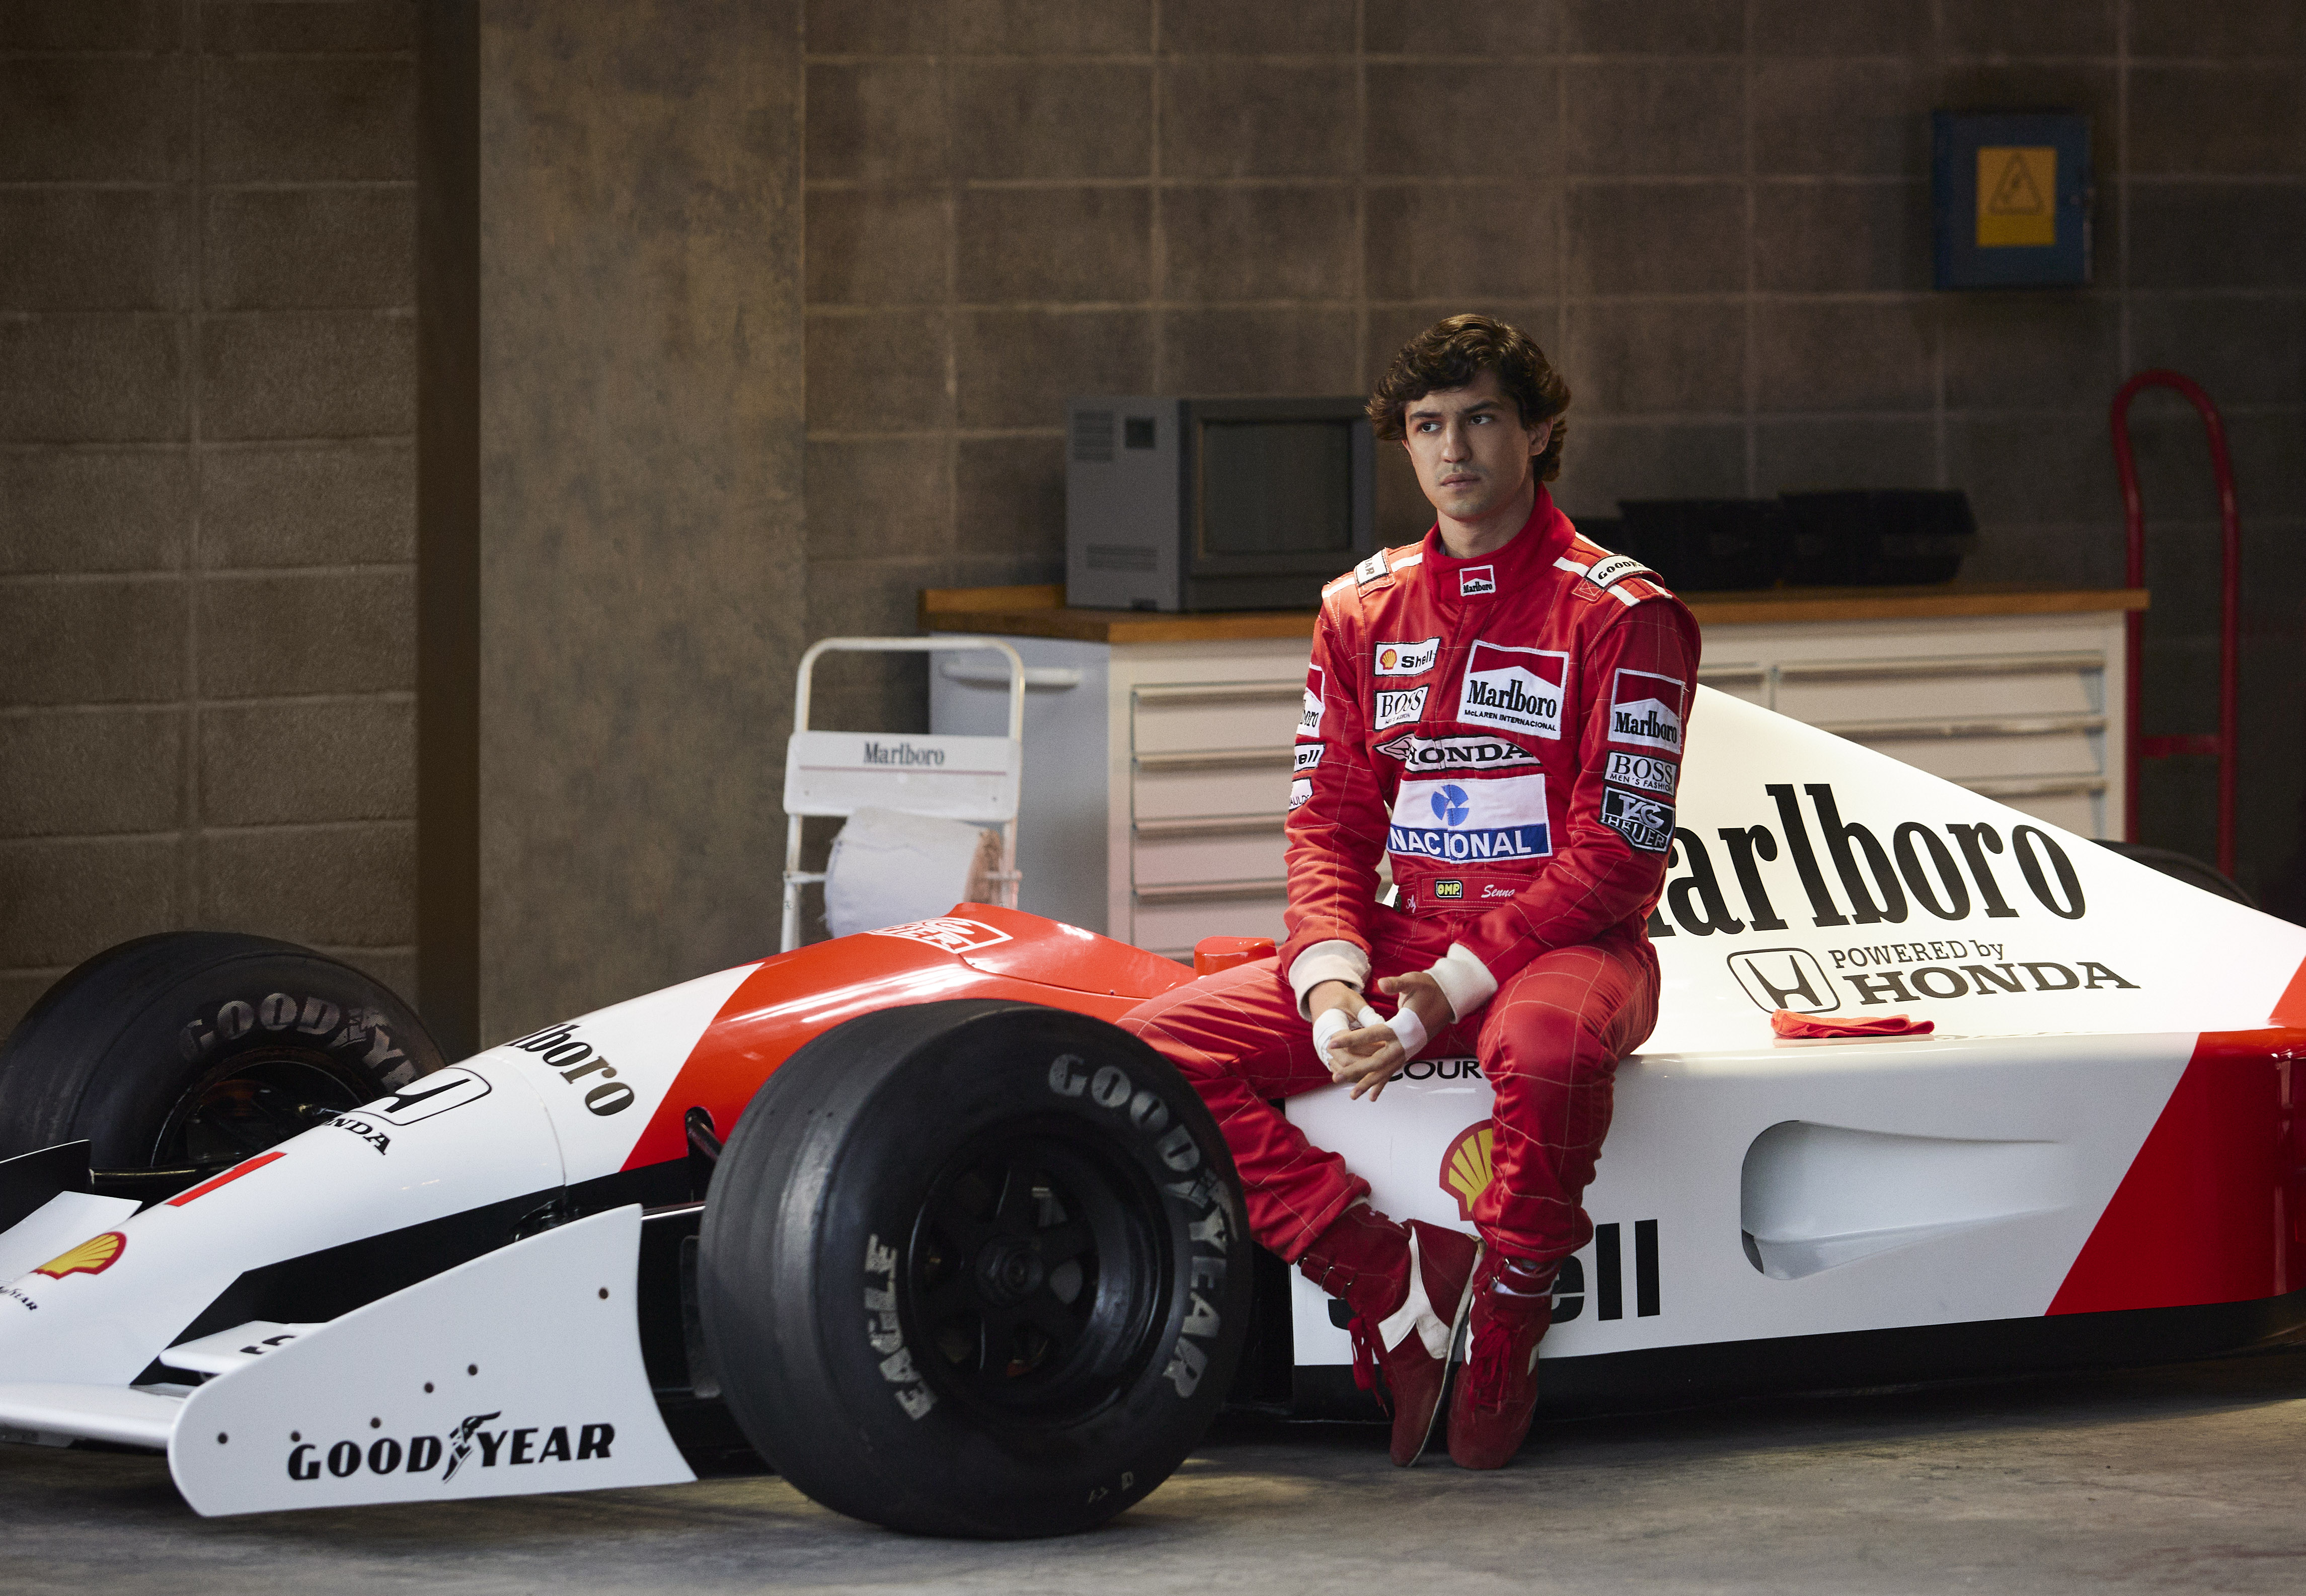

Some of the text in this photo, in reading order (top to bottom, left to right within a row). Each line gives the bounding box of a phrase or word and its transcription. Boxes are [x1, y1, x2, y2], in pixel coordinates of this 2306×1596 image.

[1463, 582, 1493, 593] Marlboro
[1402, 650, 1433, 668] Shell
[1467, 679, 1557, 718] Marlboro
[1614, 710, 1677, 744] Marlboro
[864, 742, 945, 765] Marlboro
[1612, 755, 1672, 785] BOSS
[1390, 827, 1532, 858] NACIONAL
[1648, 783, 2086, 937] arlboro
[1828, 939, 2004, 969] POWERED by
[1842, 962, 2141, 1005] HONDA
[1048, 1054, 1229, 1398] GOODYEAR
[864, 1233, 938, 1421] EAGLE
[287, 1422, 616, 1481] GOODYEAR
